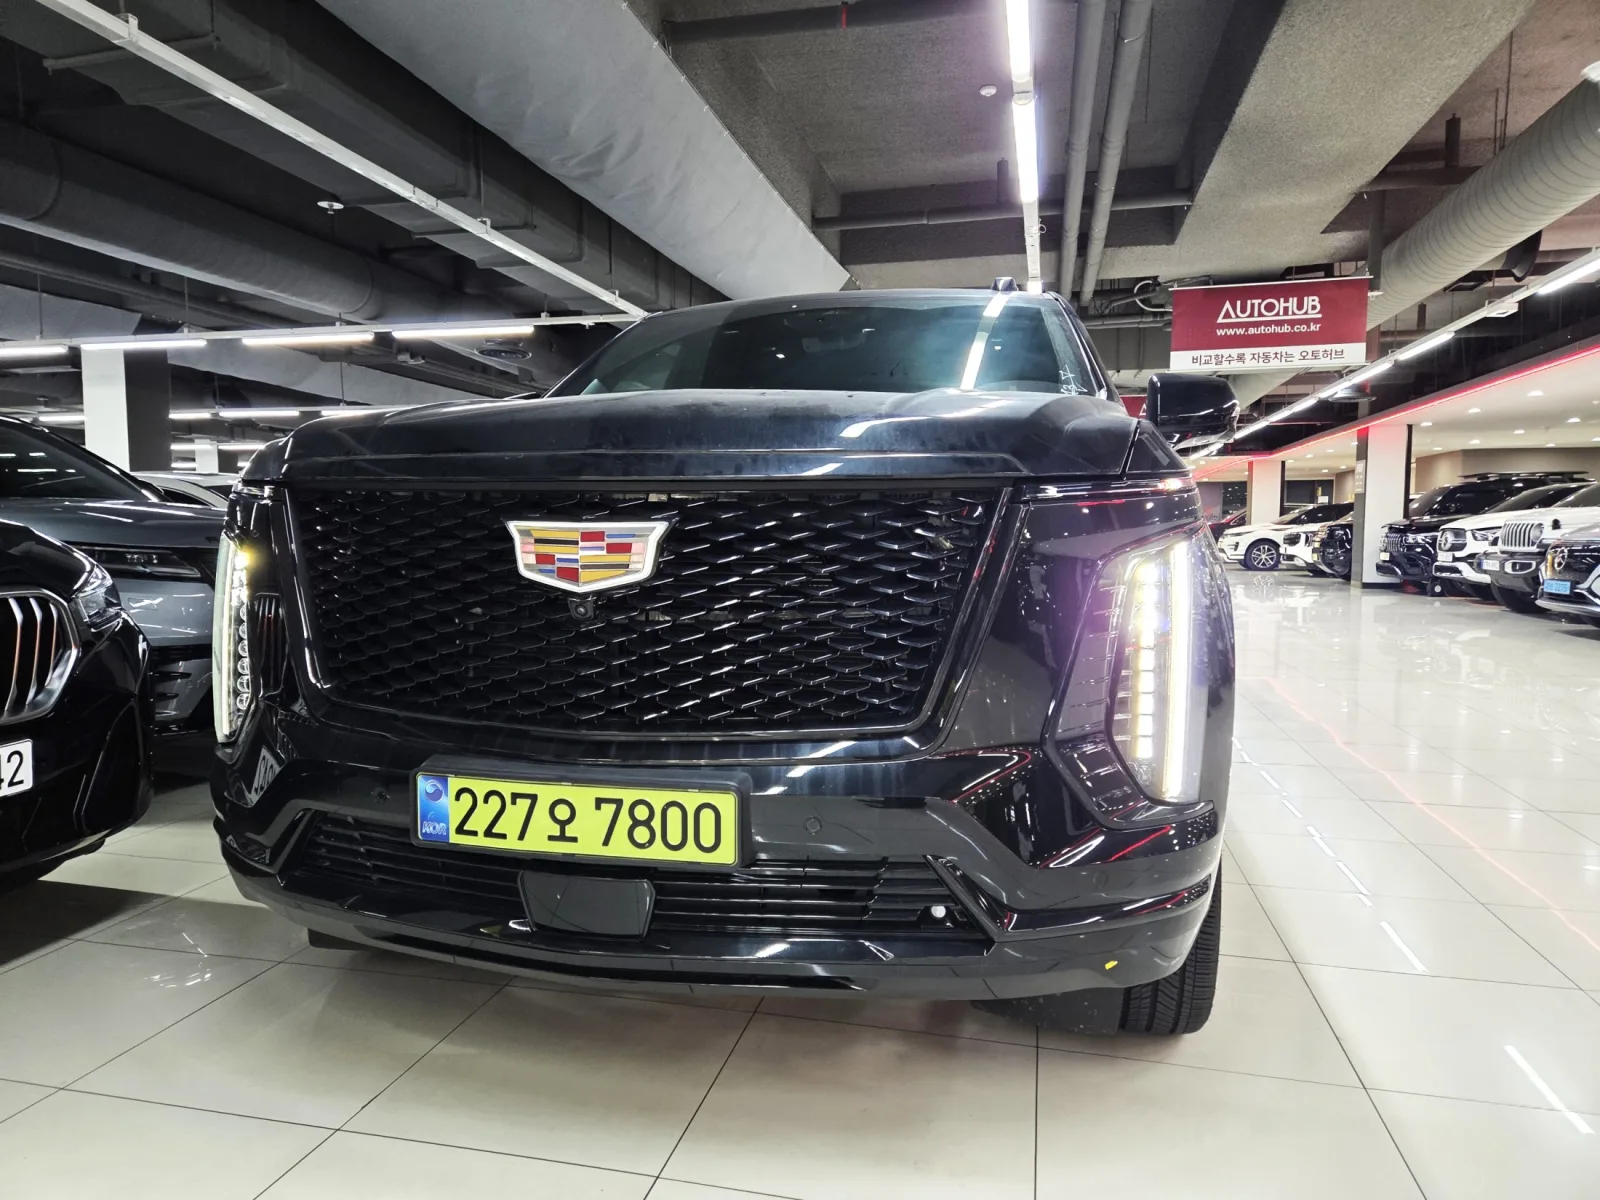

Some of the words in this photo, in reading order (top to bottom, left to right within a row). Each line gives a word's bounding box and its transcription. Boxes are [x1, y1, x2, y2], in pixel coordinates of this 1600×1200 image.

[1216, 295, 1322, 323] AUTOHUB
[1216, 322, 1321, 336] www.autohub.co.kr
[1191, 352, 1246, 366] 비교할수록
[1249, 350, 1295, 364] 자동차는
[1298, 348, 1345, 361] 오토허브
[0, 750, 24, 788] 2
[422, 820, 447, 836] KOR
[454, 787, 578, 844] 227오
[594, 797, 722, 853] 7800
